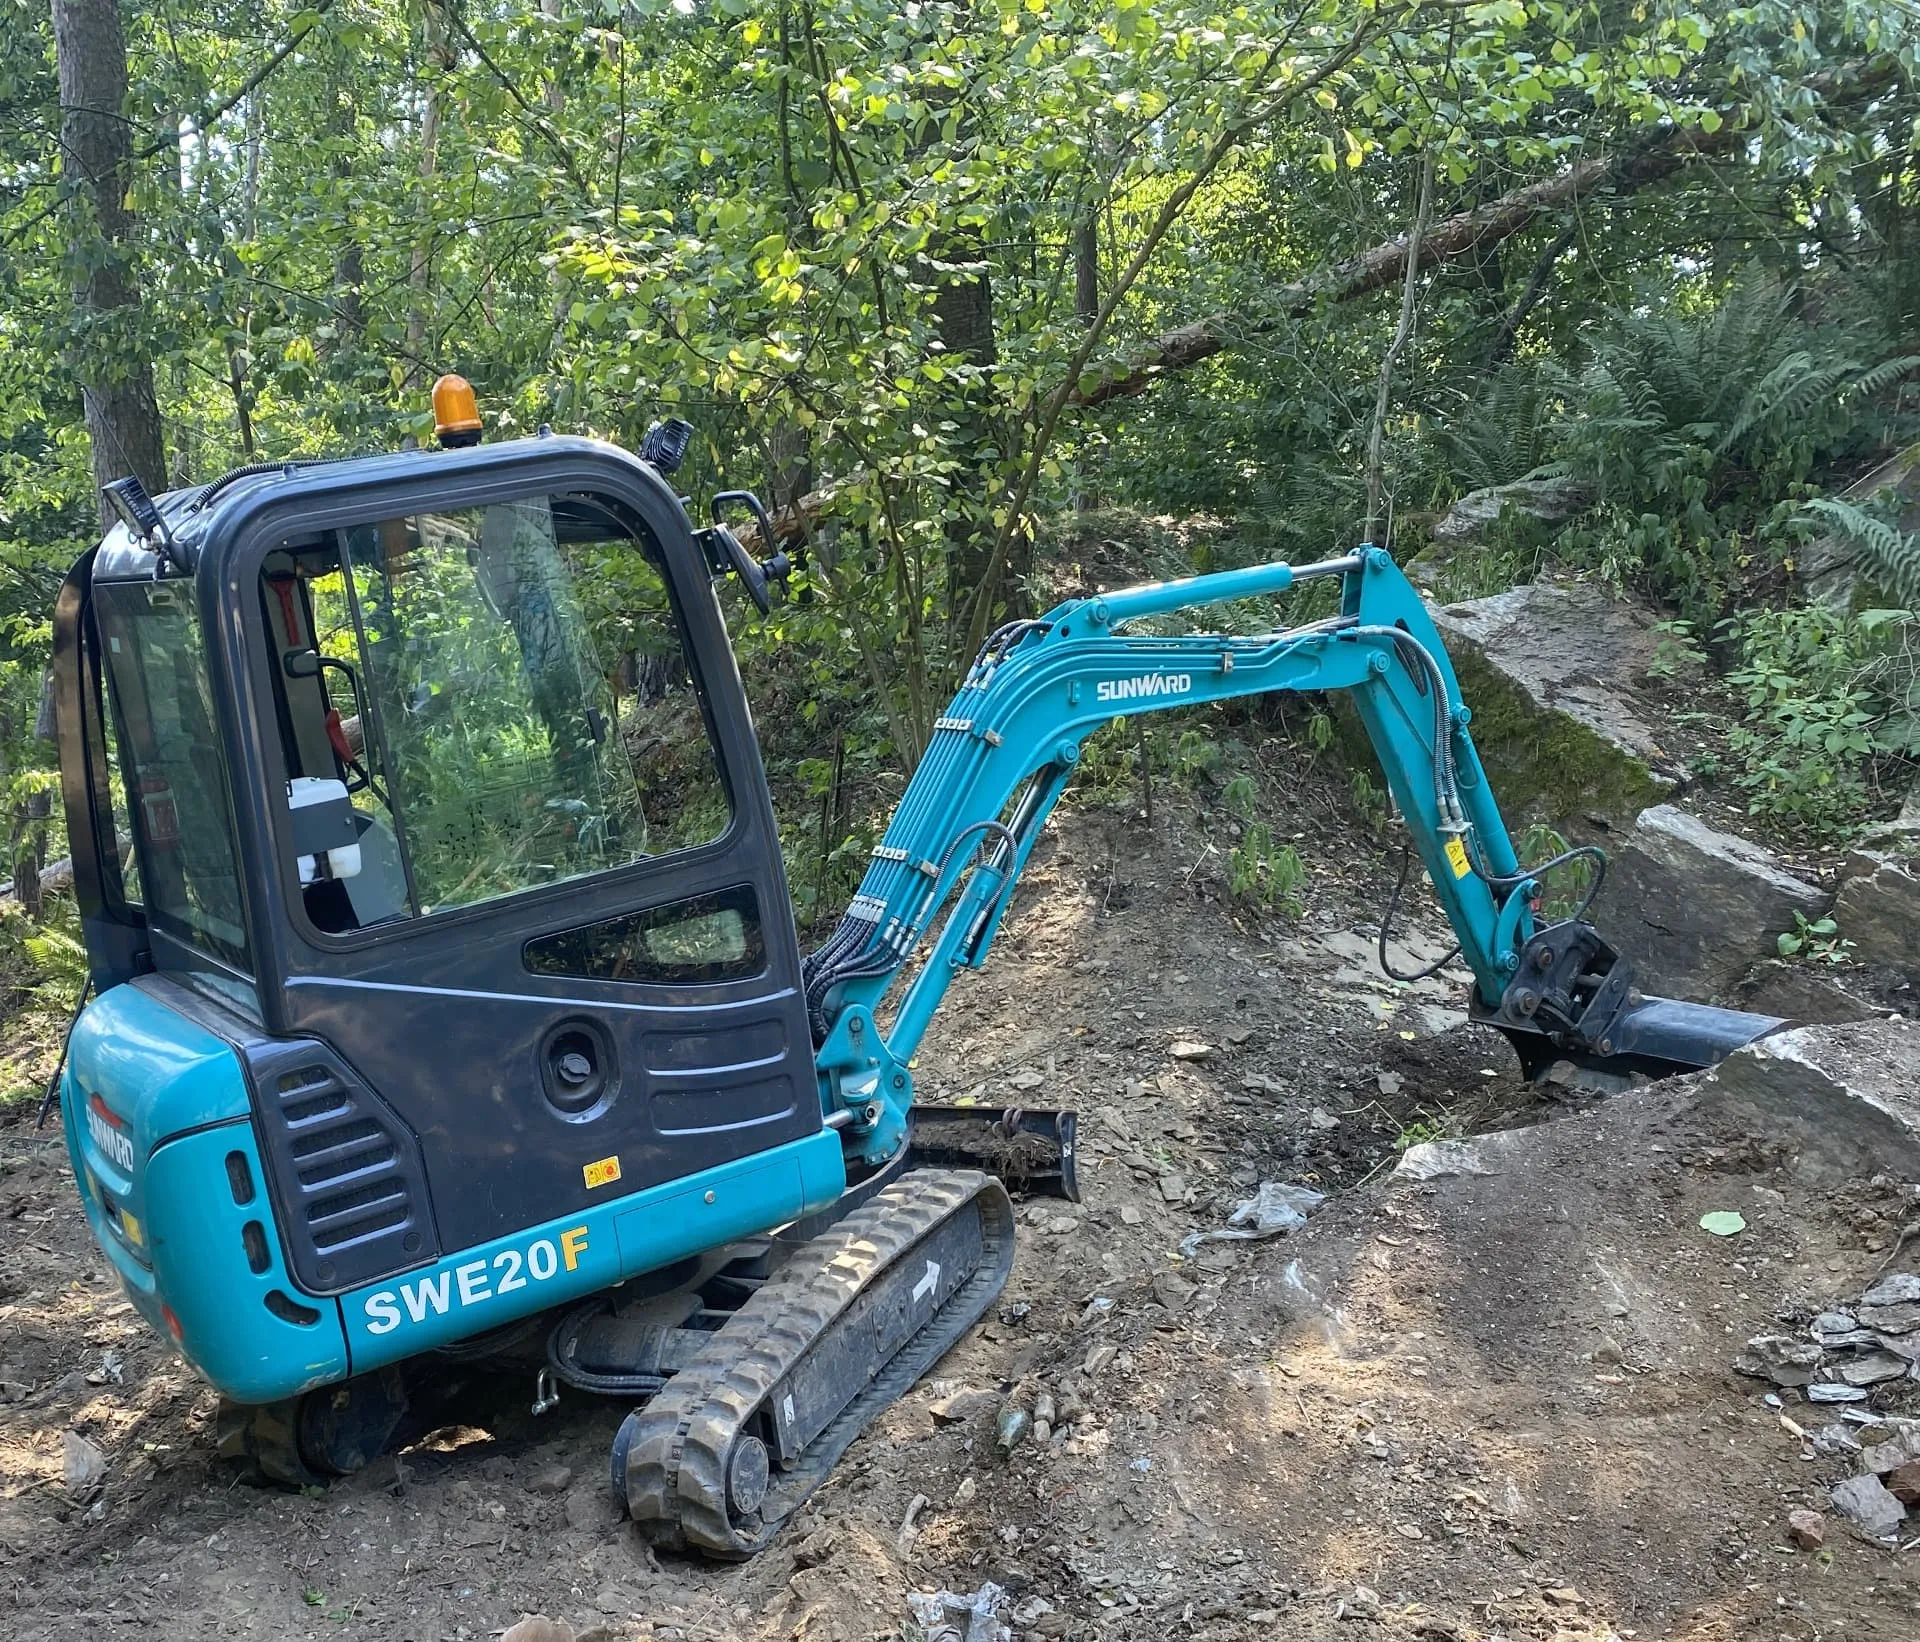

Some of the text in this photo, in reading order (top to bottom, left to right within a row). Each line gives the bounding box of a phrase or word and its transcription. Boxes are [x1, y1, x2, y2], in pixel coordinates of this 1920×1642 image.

[1097, 672, 1191, 701] SUNWARD
[85, 1103, 134, 1173] SUNWARD
[364, 1225, 588, 1335] SWE20F
